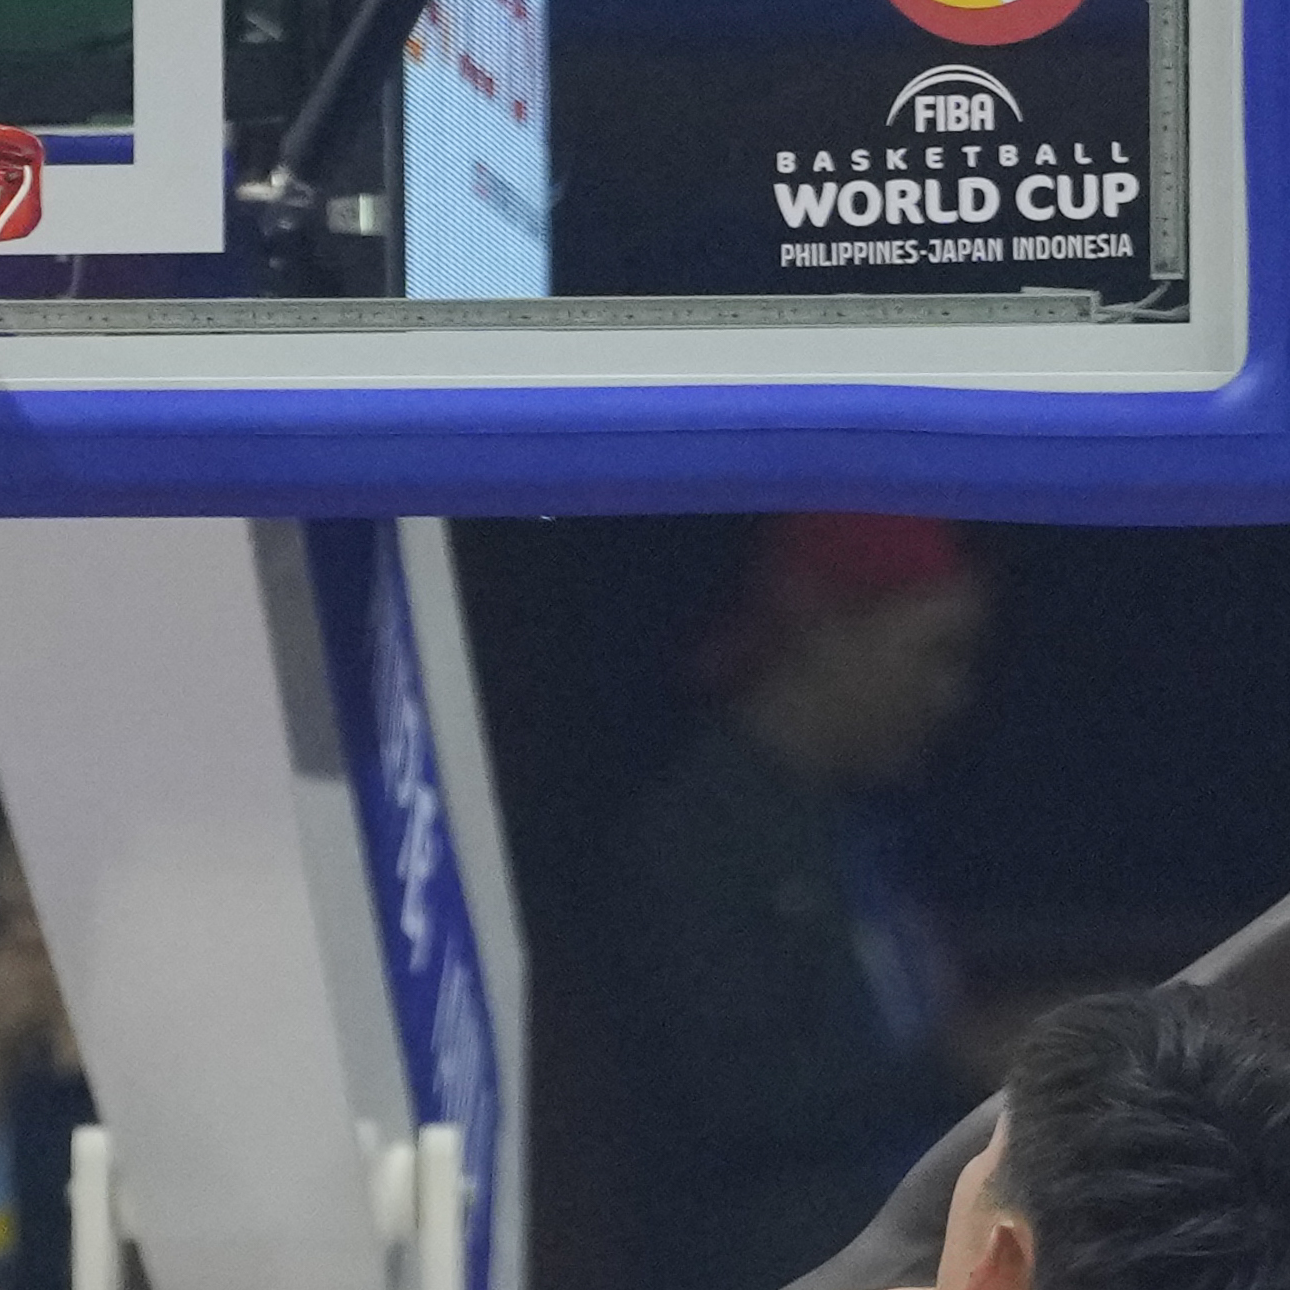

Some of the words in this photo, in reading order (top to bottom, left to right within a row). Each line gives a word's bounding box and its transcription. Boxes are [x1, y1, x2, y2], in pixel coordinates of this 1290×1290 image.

[914, 93, 995, 133] FIBA
[776, 141, 1129, 174] BASKETBALL
[773, 176, 1001, 229] WORLD
[1015, 172, 1140, 222] CUP
[1013, 233, 1134, 262] INDONESIA
